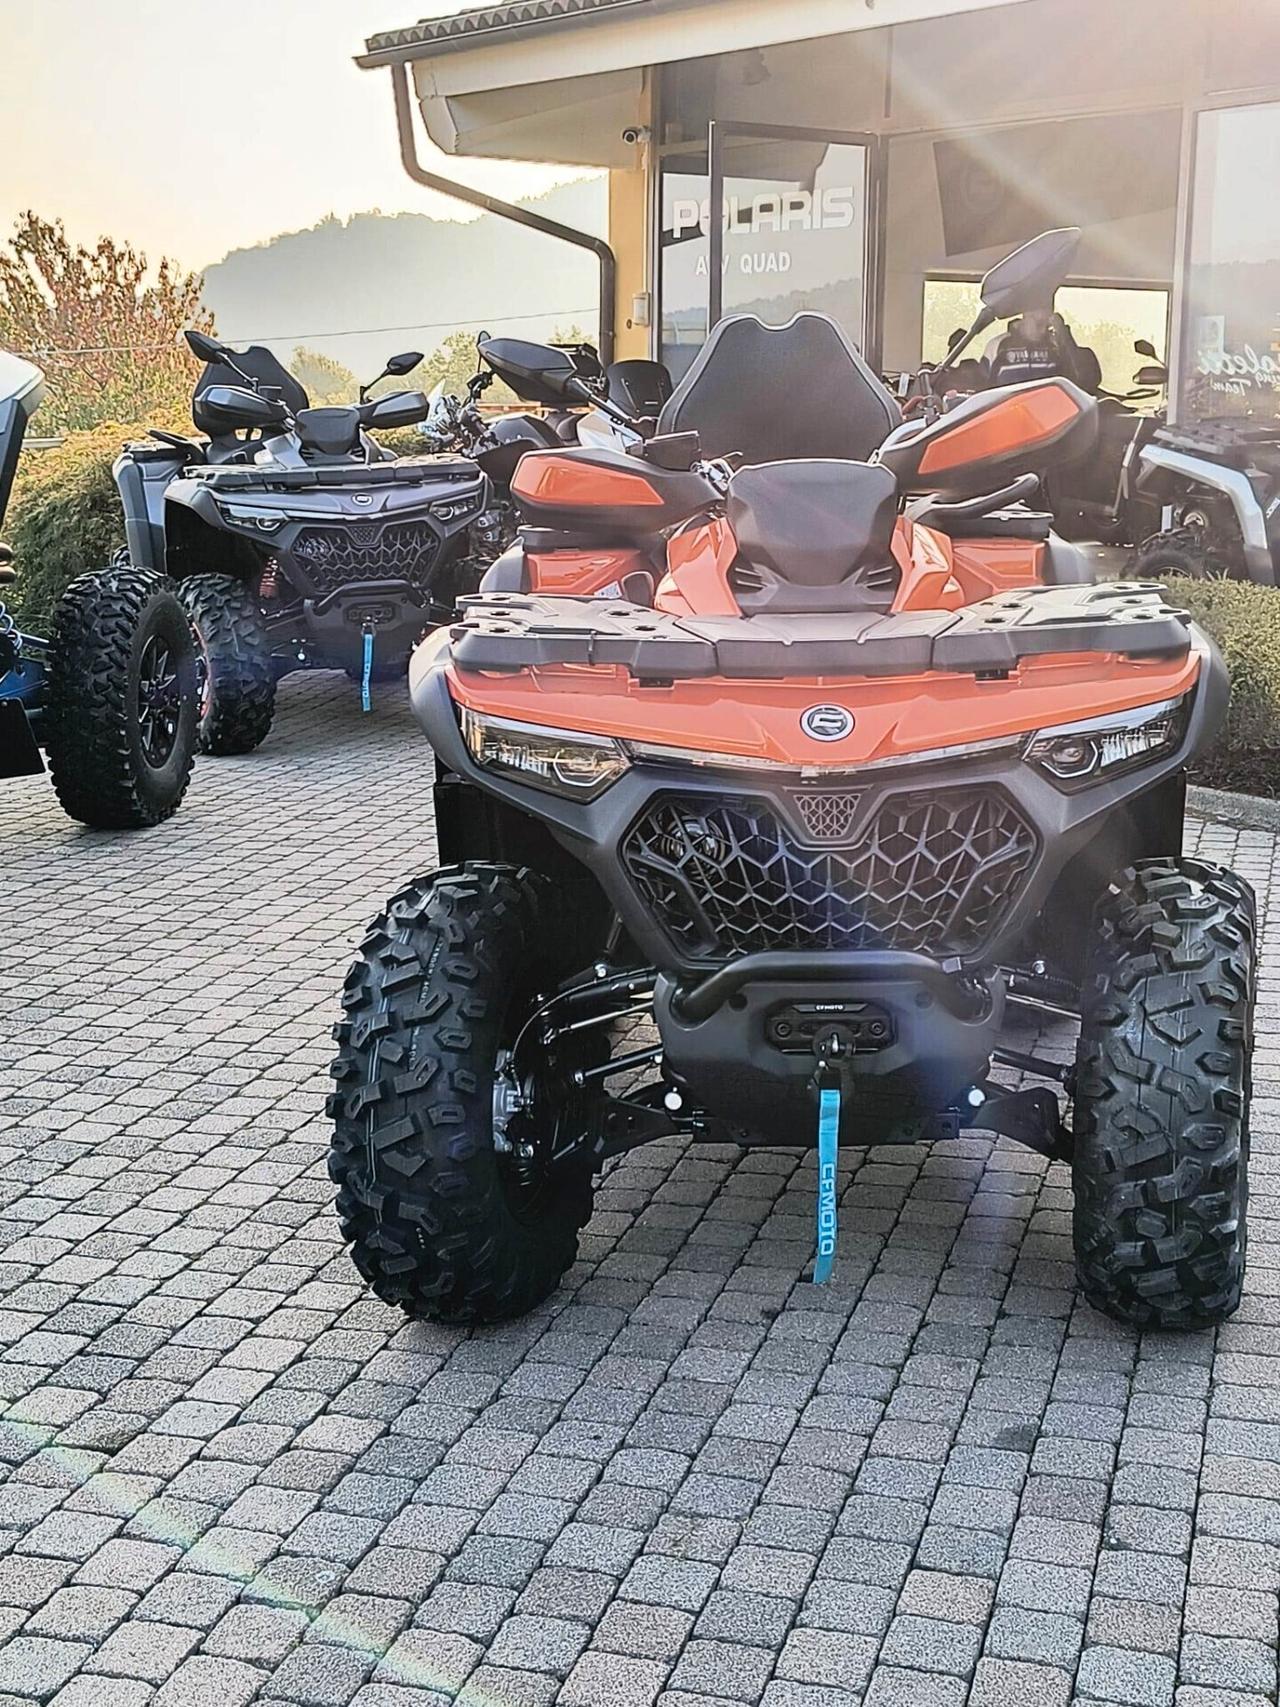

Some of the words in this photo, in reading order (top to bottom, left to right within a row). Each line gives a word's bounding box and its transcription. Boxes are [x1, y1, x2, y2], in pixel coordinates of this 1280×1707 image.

[672, 187, 854, 238] POLARIS
[695, 254, 730, 275] AV
[740, 252, 791, 274] QUAD
[821, 1163, 835, 1256] CFMOTO
